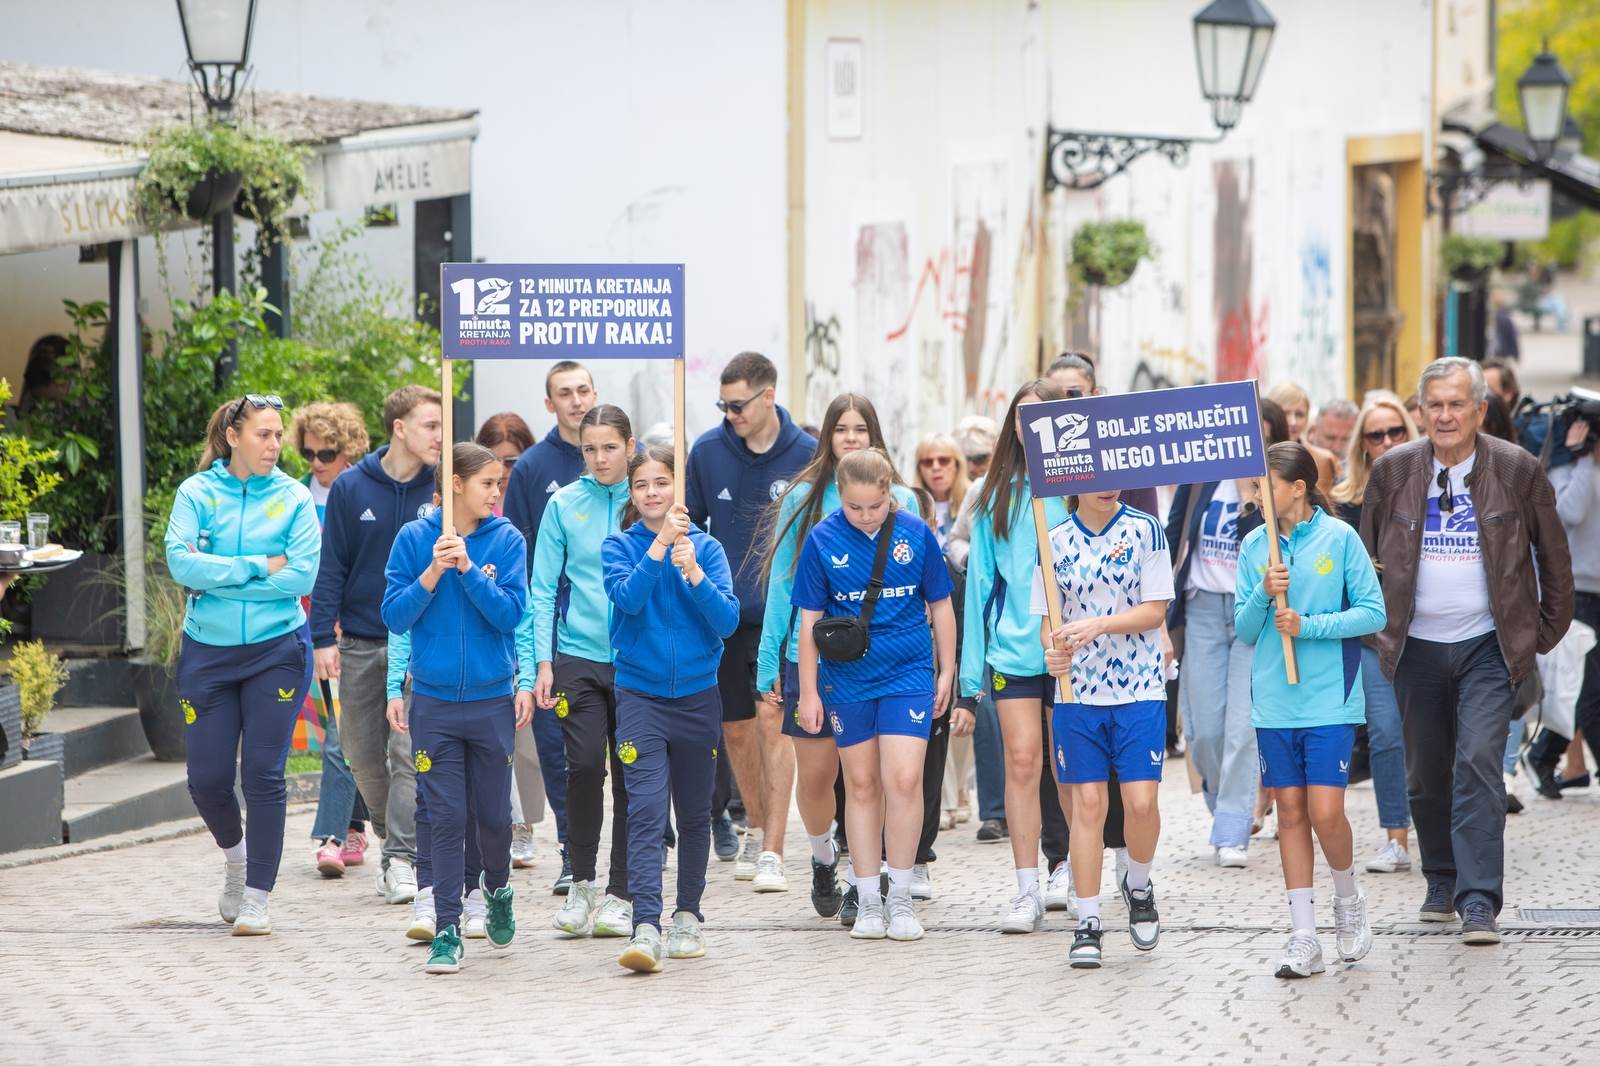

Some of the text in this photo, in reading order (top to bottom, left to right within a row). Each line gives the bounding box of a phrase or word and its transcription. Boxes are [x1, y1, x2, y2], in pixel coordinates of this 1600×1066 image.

[60, 197, 136, 234] SLITK
[520, 278, 672, 294] 12 MINUTA KRETANJA
[451, 277, 513, 315] 12
[520, 299, 672, 317] ZA 12 PREPORUKA
[459, 316, 511, 330] minuta
[459, 330, 511, 338] KRETANJA
[519, 322, 673, 345] PROTIV RAKA!
[1096, 403, 1249, 439] BOLJE SPRIJEČITI
[1029, 413, 1090, 454] 12
[1043, 453, 1094, 468] minuta
[1100, 433, 1252, 472] NEGO LIJEČITI!
[1044, 465, 1095, 477] KRETANJA
[1046, 473, 1096, 484] PROTIV RAKA
[1202, 538, 1241, 553] minut
[848, 585, 917, 601] FBET
